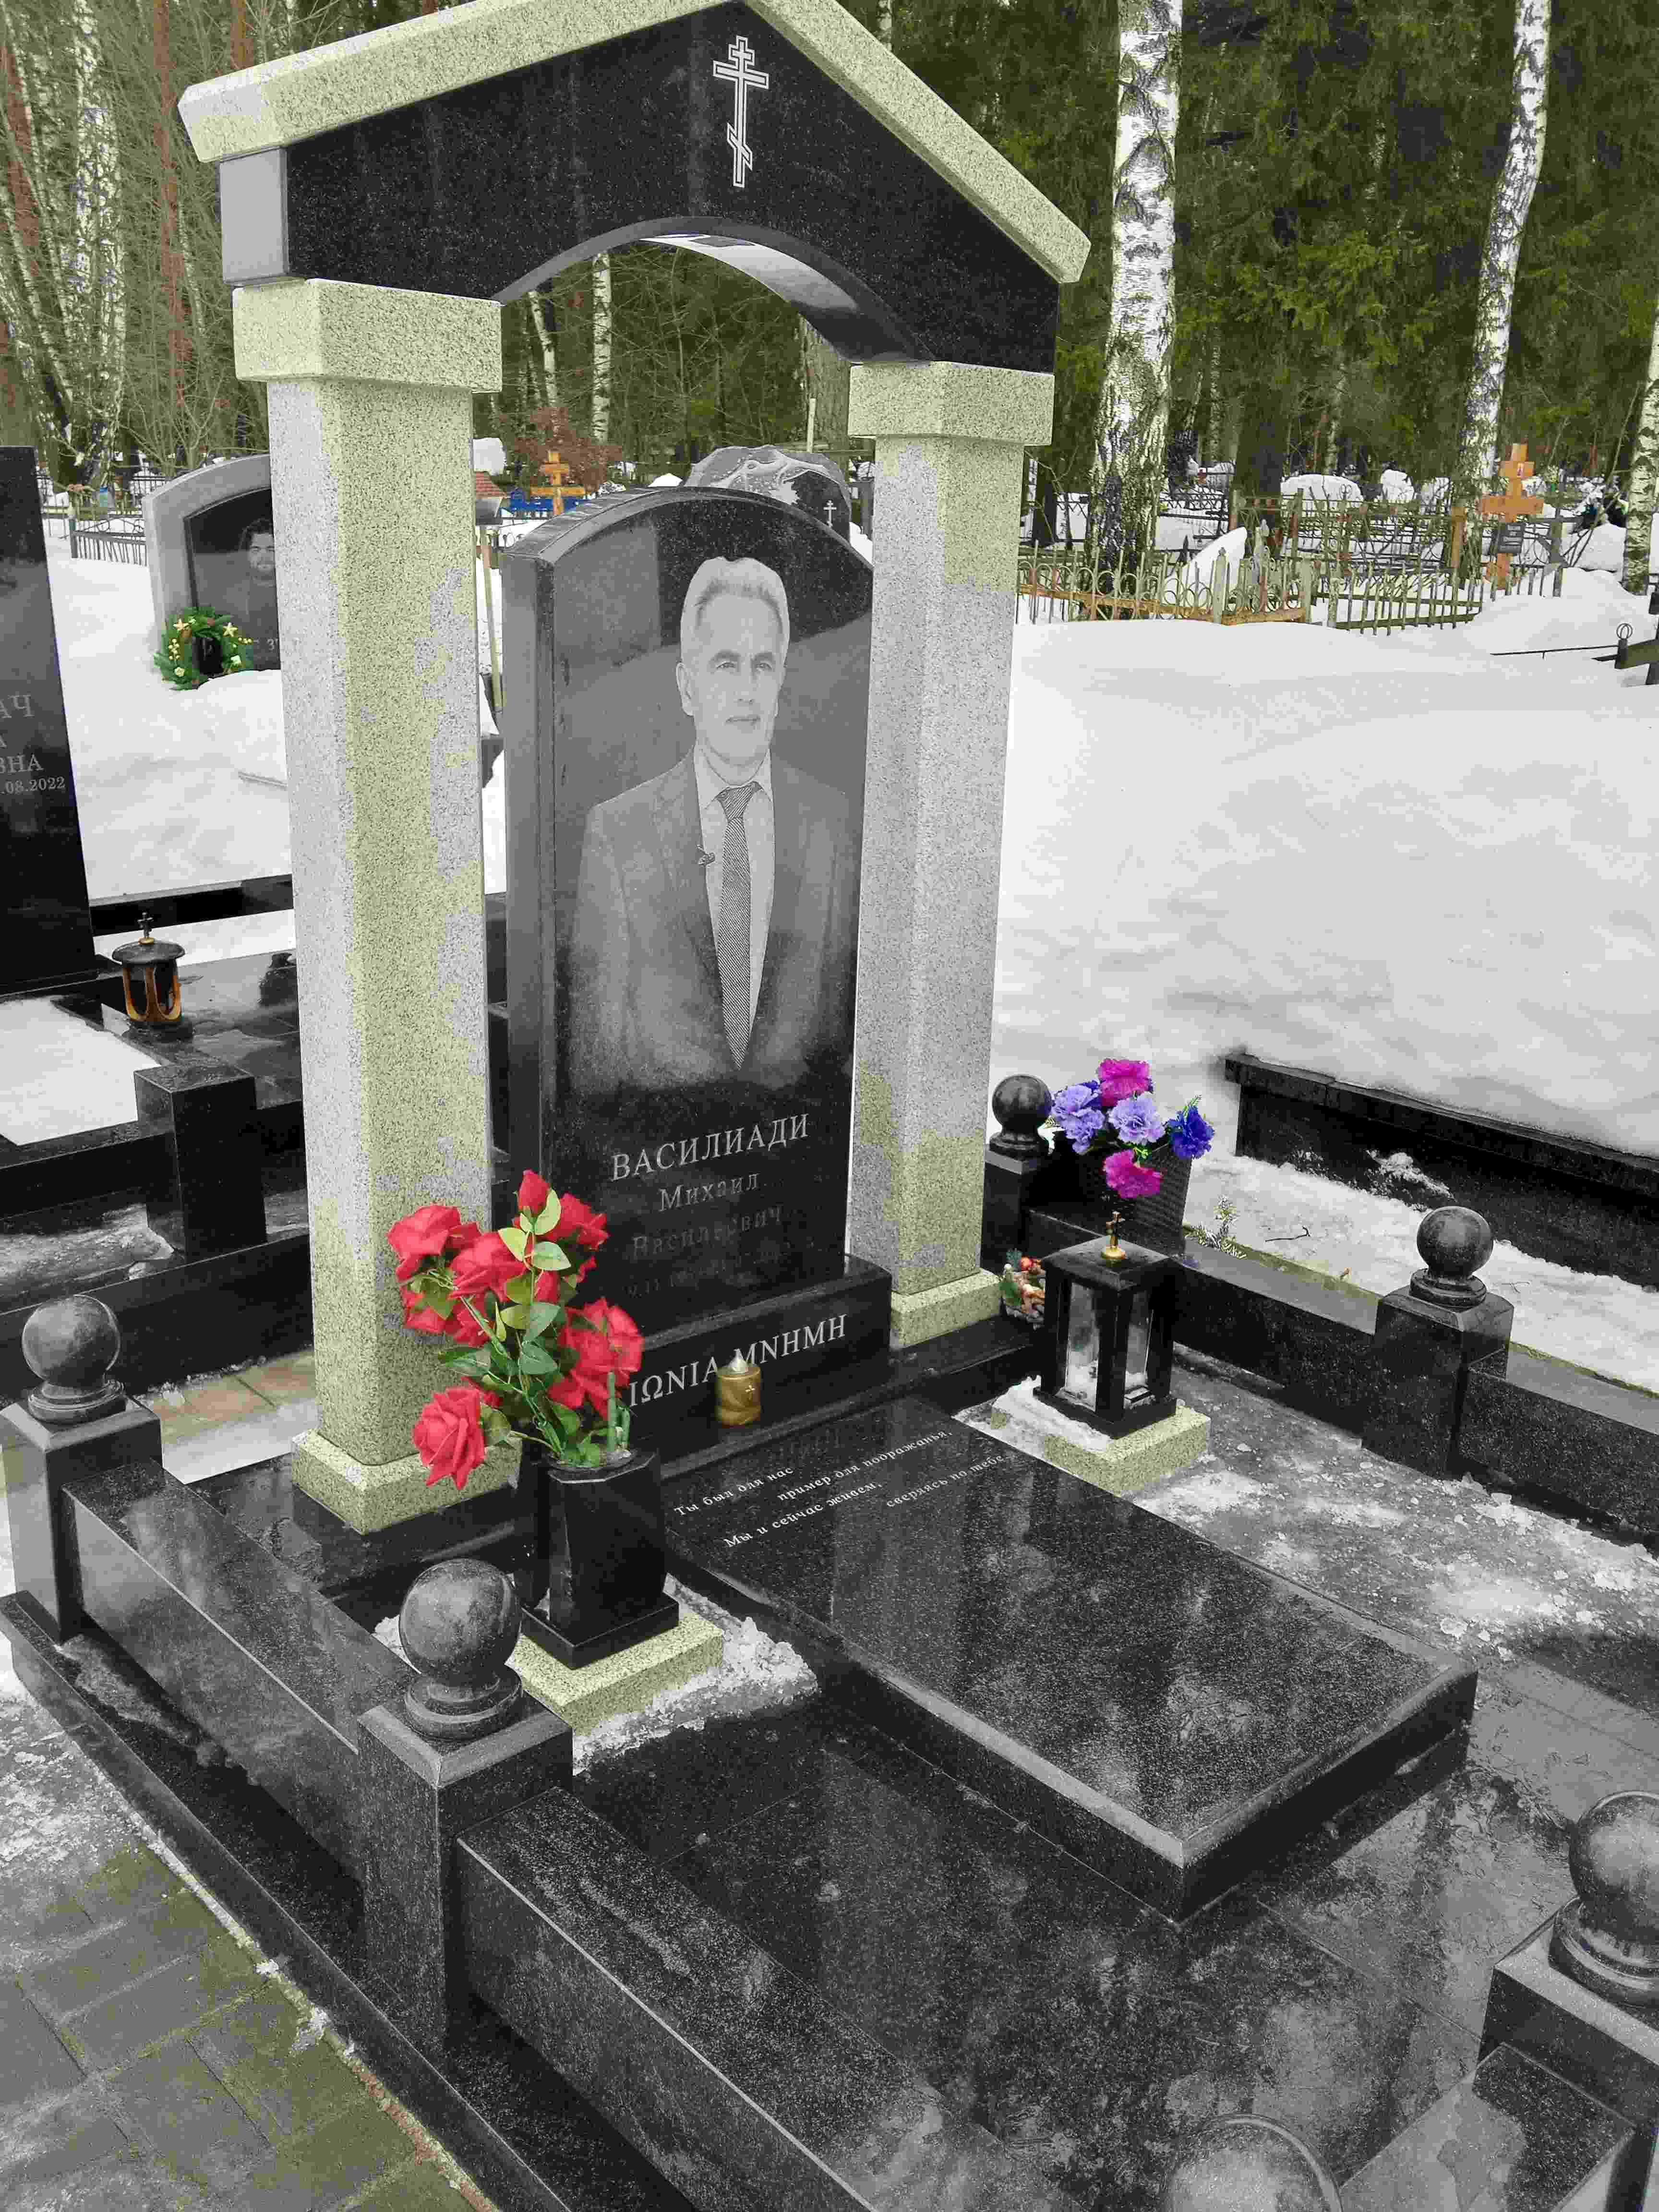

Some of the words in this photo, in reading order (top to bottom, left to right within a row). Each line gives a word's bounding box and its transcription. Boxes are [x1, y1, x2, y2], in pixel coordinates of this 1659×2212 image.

[611, 1114, 809, 1181] ВАСИЛИАДИ
[659, 1173, 760, 1212] Михаил
[674, 1504, 699, 1516] Ты
[703, 1490, 734, 1505] был
[737, 1479, 764, 1492] для
[768, 1467, 794, 1481] нас
[777, 1475, 832, 1501] пример
[835, 1465, 861, 1479] для
[887, 1479, 948, 1507] сверяясь
[950, 1470, 968, 1480] по
[724, 1533, 753, 1548] Мы
[756, 1527, 769, 1535] и
[771, 1503, 824, 1528] сейчас
